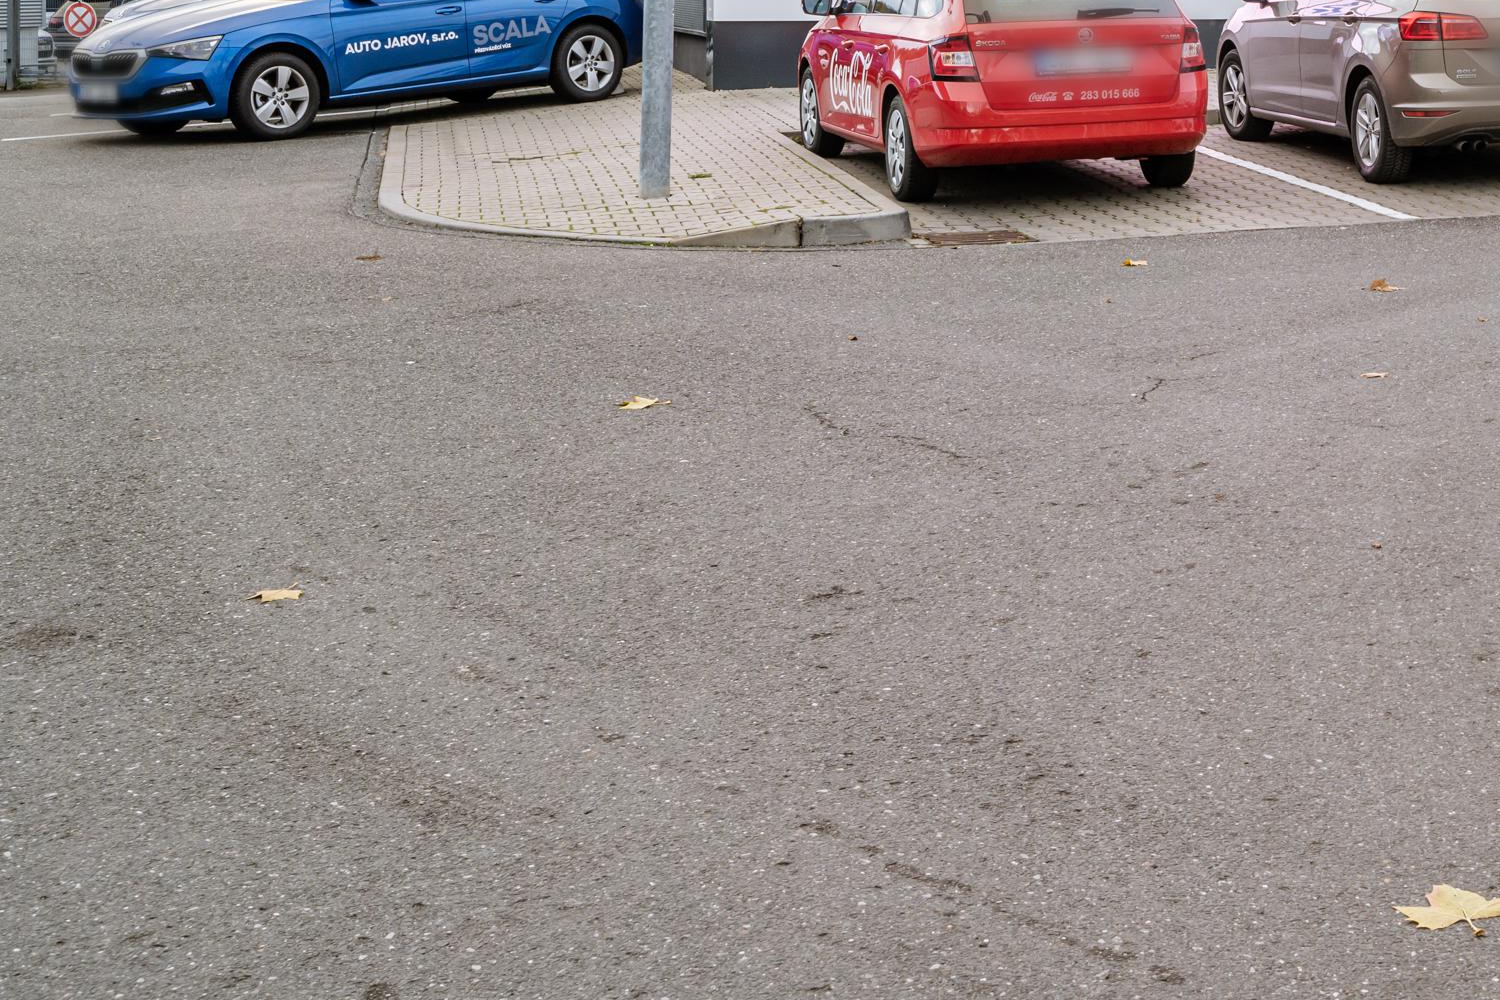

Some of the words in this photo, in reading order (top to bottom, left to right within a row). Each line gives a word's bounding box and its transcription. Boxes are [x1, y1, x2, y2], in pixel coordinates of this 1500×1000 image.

[473, 15, 551, 46] SCALA
[345, 38, 382, 55] AUTO
[384, 32, 430, 50] JAROV,
[432, 31, 459, 43] s.r.o.
[1080, 91, 1099, 100] 283
[1101, 90, 1120, 99] 015
[1122, 88, 1140, 98] 666
